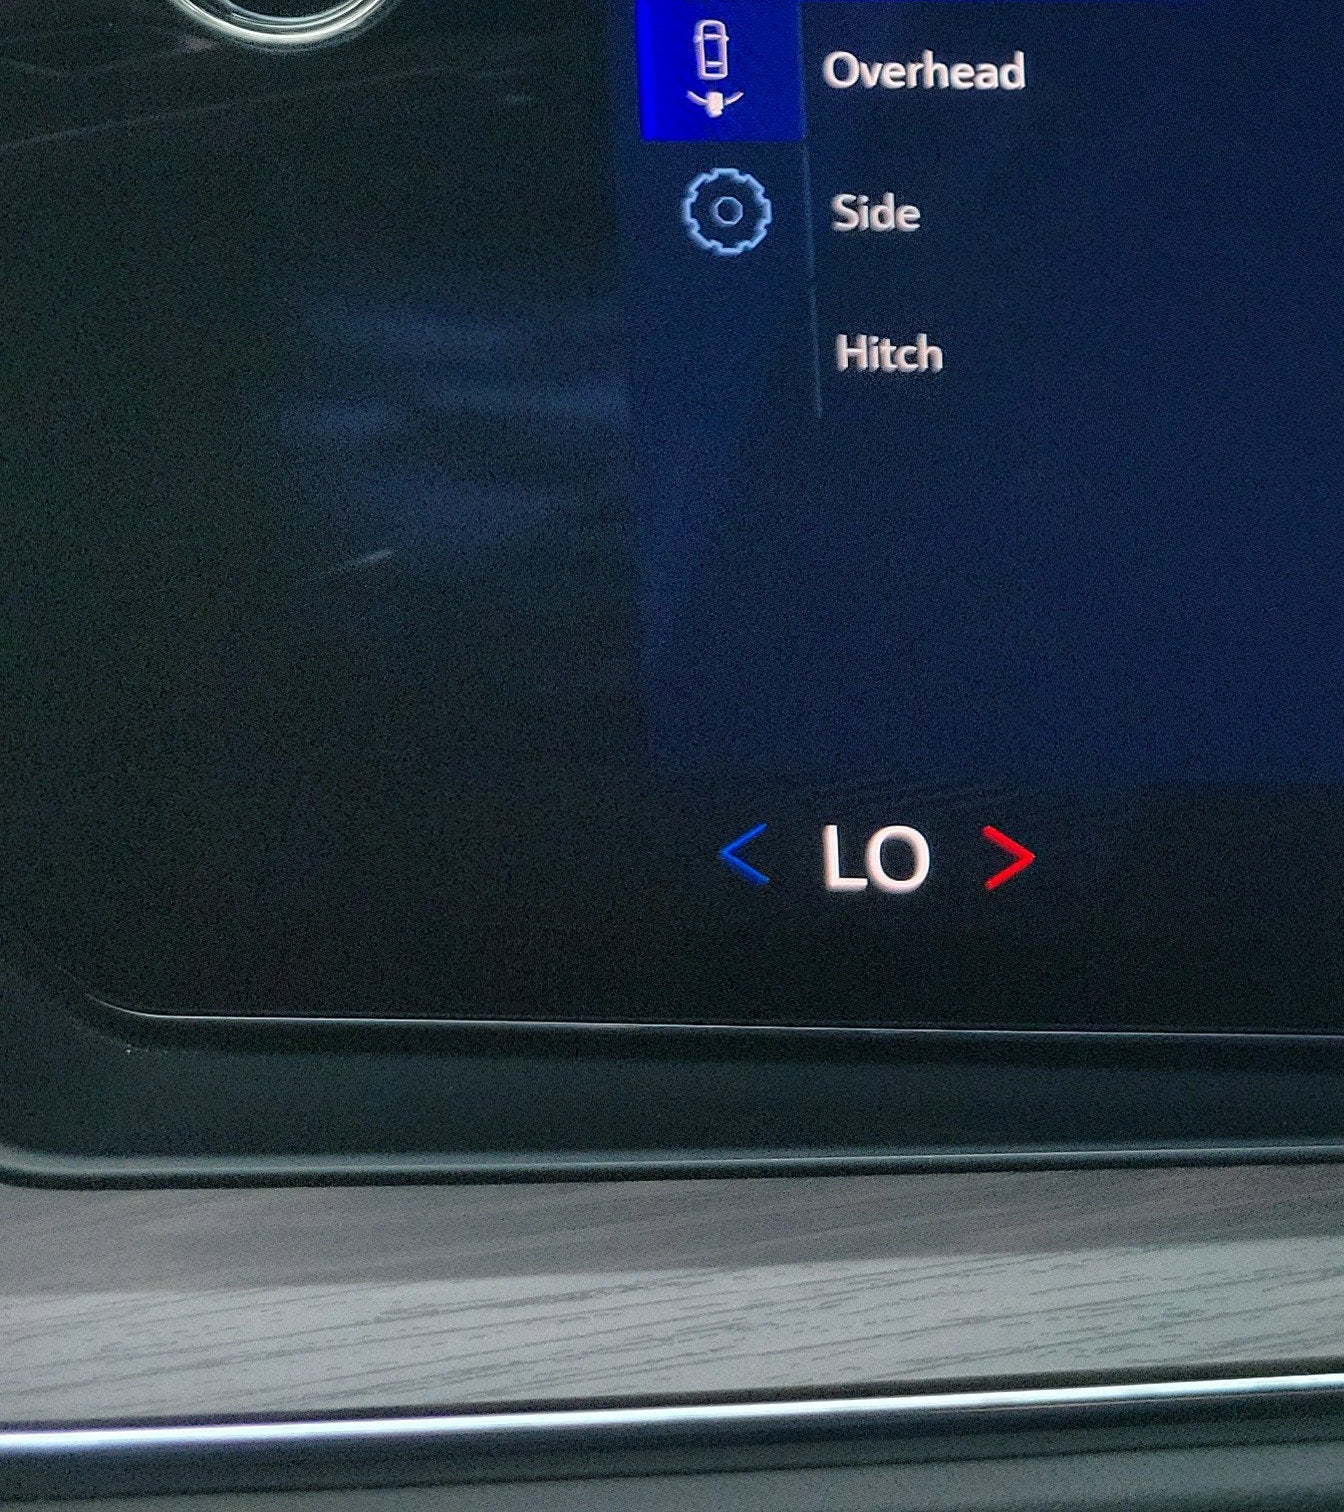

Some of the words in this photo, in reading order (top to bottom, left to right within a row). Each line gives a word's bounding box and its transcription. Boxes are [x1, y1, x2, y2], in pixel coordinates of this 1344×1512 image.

[822, 50, 1027, 90] Overhead
[830, 192, 922, 233] Side
[835, 333, 944, 373] Hitch
[821, 823, 932, 895] LO
